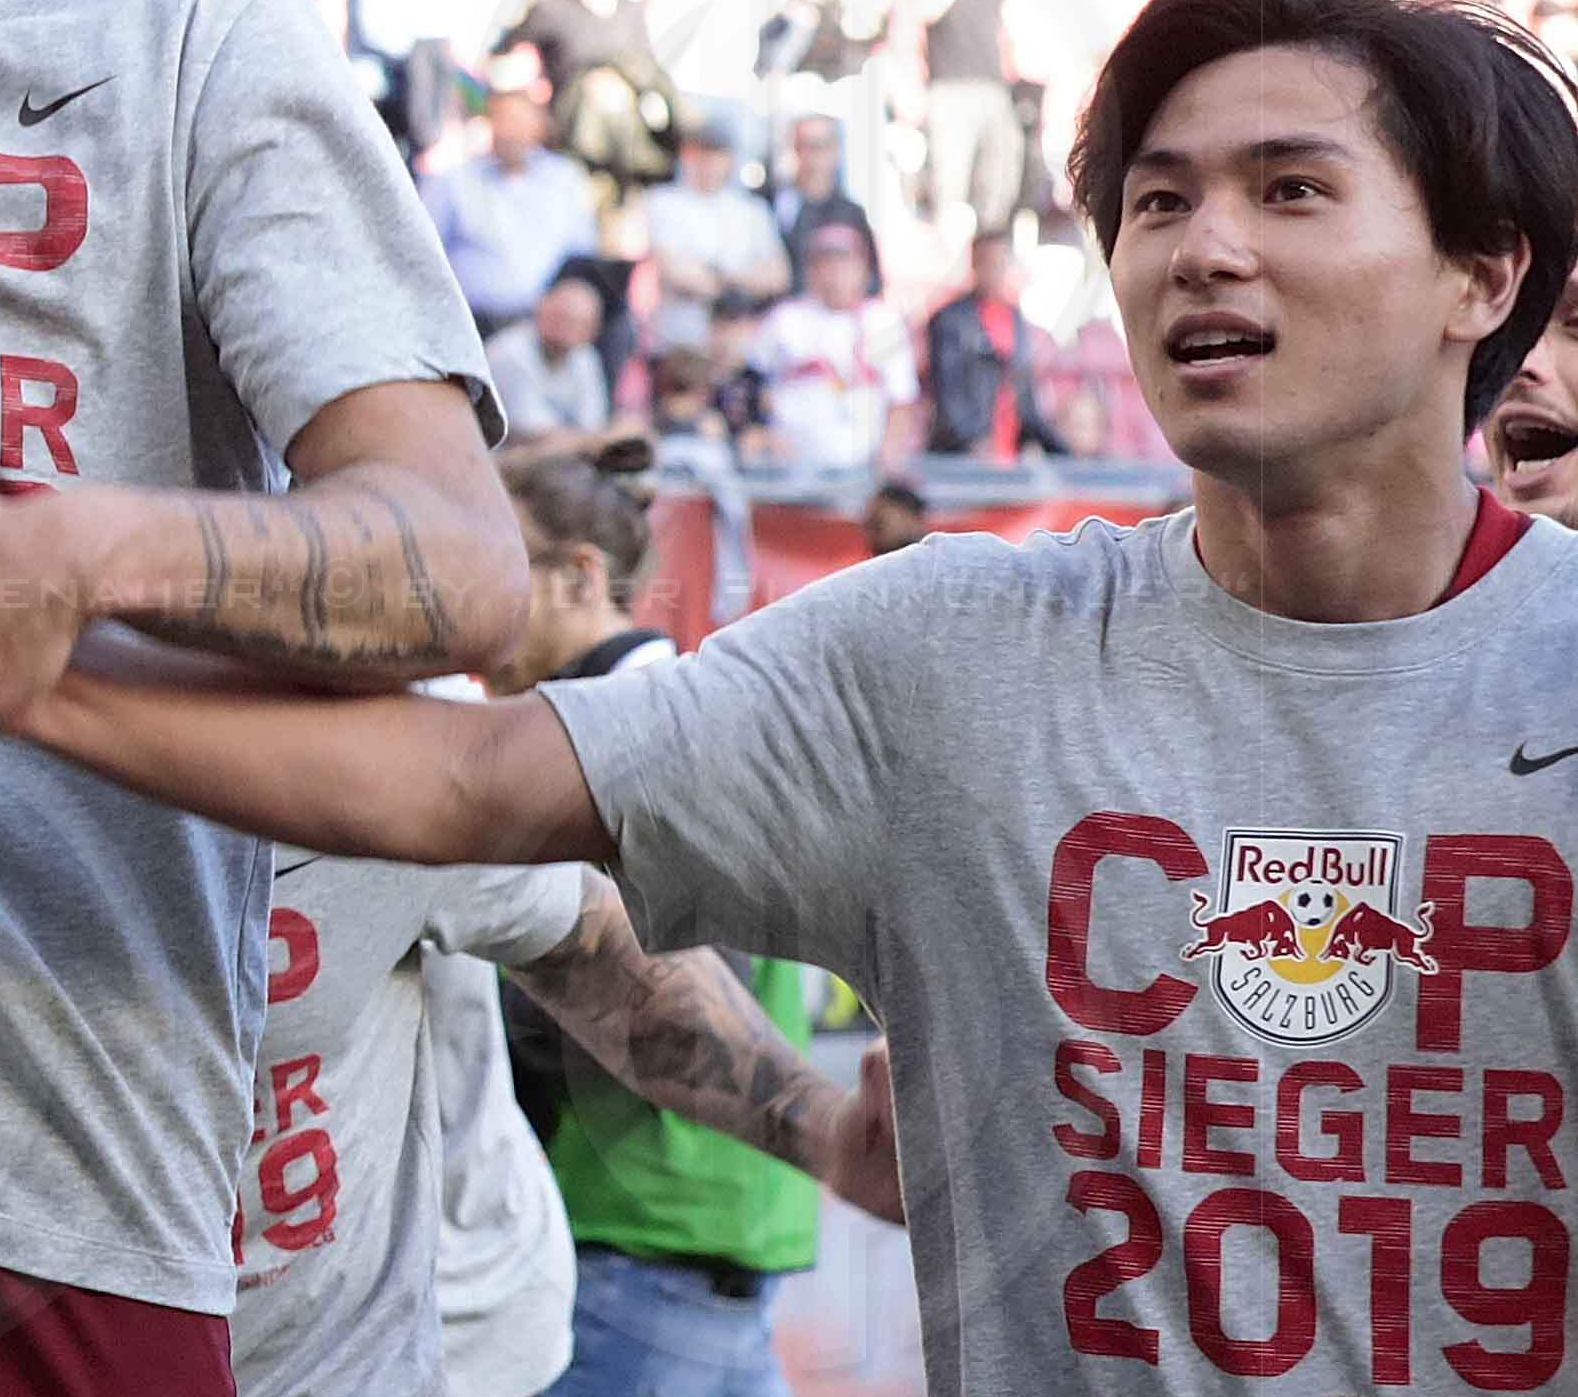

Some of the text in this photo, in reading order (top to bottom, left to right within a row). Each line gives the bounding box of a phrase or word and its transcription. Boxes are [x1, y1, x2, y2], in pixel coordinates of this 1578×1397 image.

[1230, 967, 1375, 1030] SALZBURG
[1052, 1039, 1567, 1189] SIEGER
[1063, 1170, 1568, 1391] 2019
